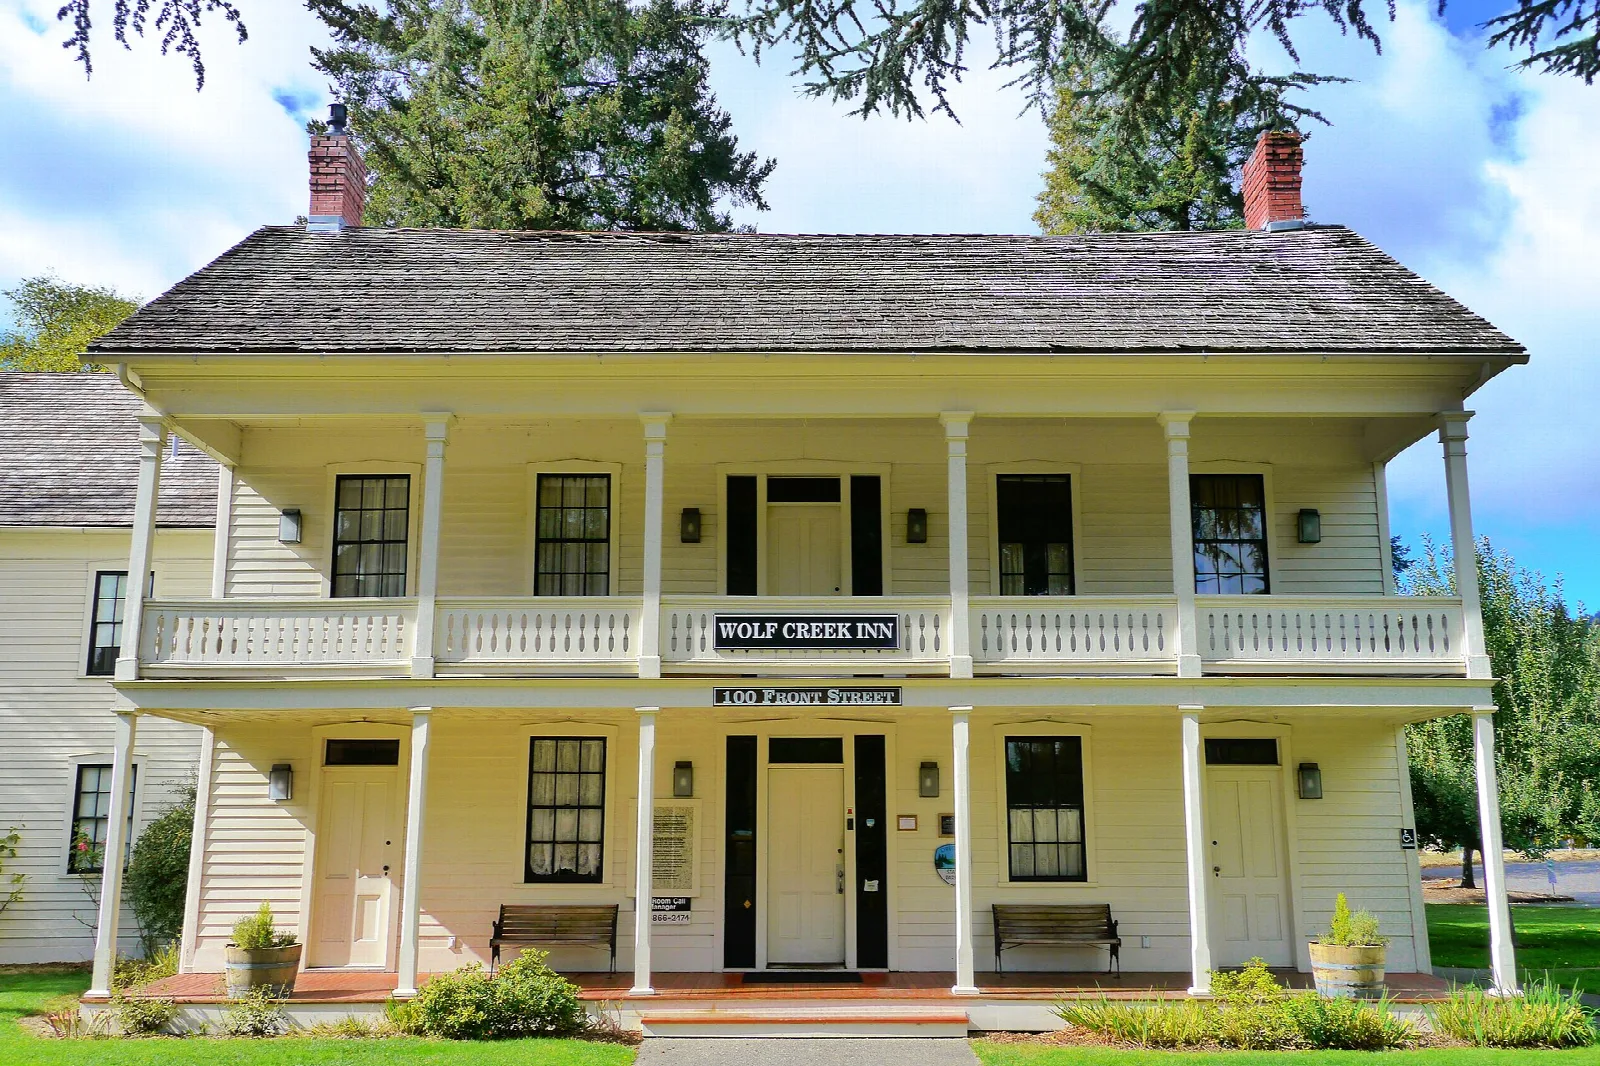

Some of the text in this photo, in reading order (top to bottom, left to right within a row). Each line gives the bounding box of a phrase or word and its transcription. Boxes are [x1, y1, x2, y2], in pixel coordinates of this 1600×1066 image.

[718, 622, 894, 639] WOLF CREEK INN
[722, 690, 757, 704] 100
